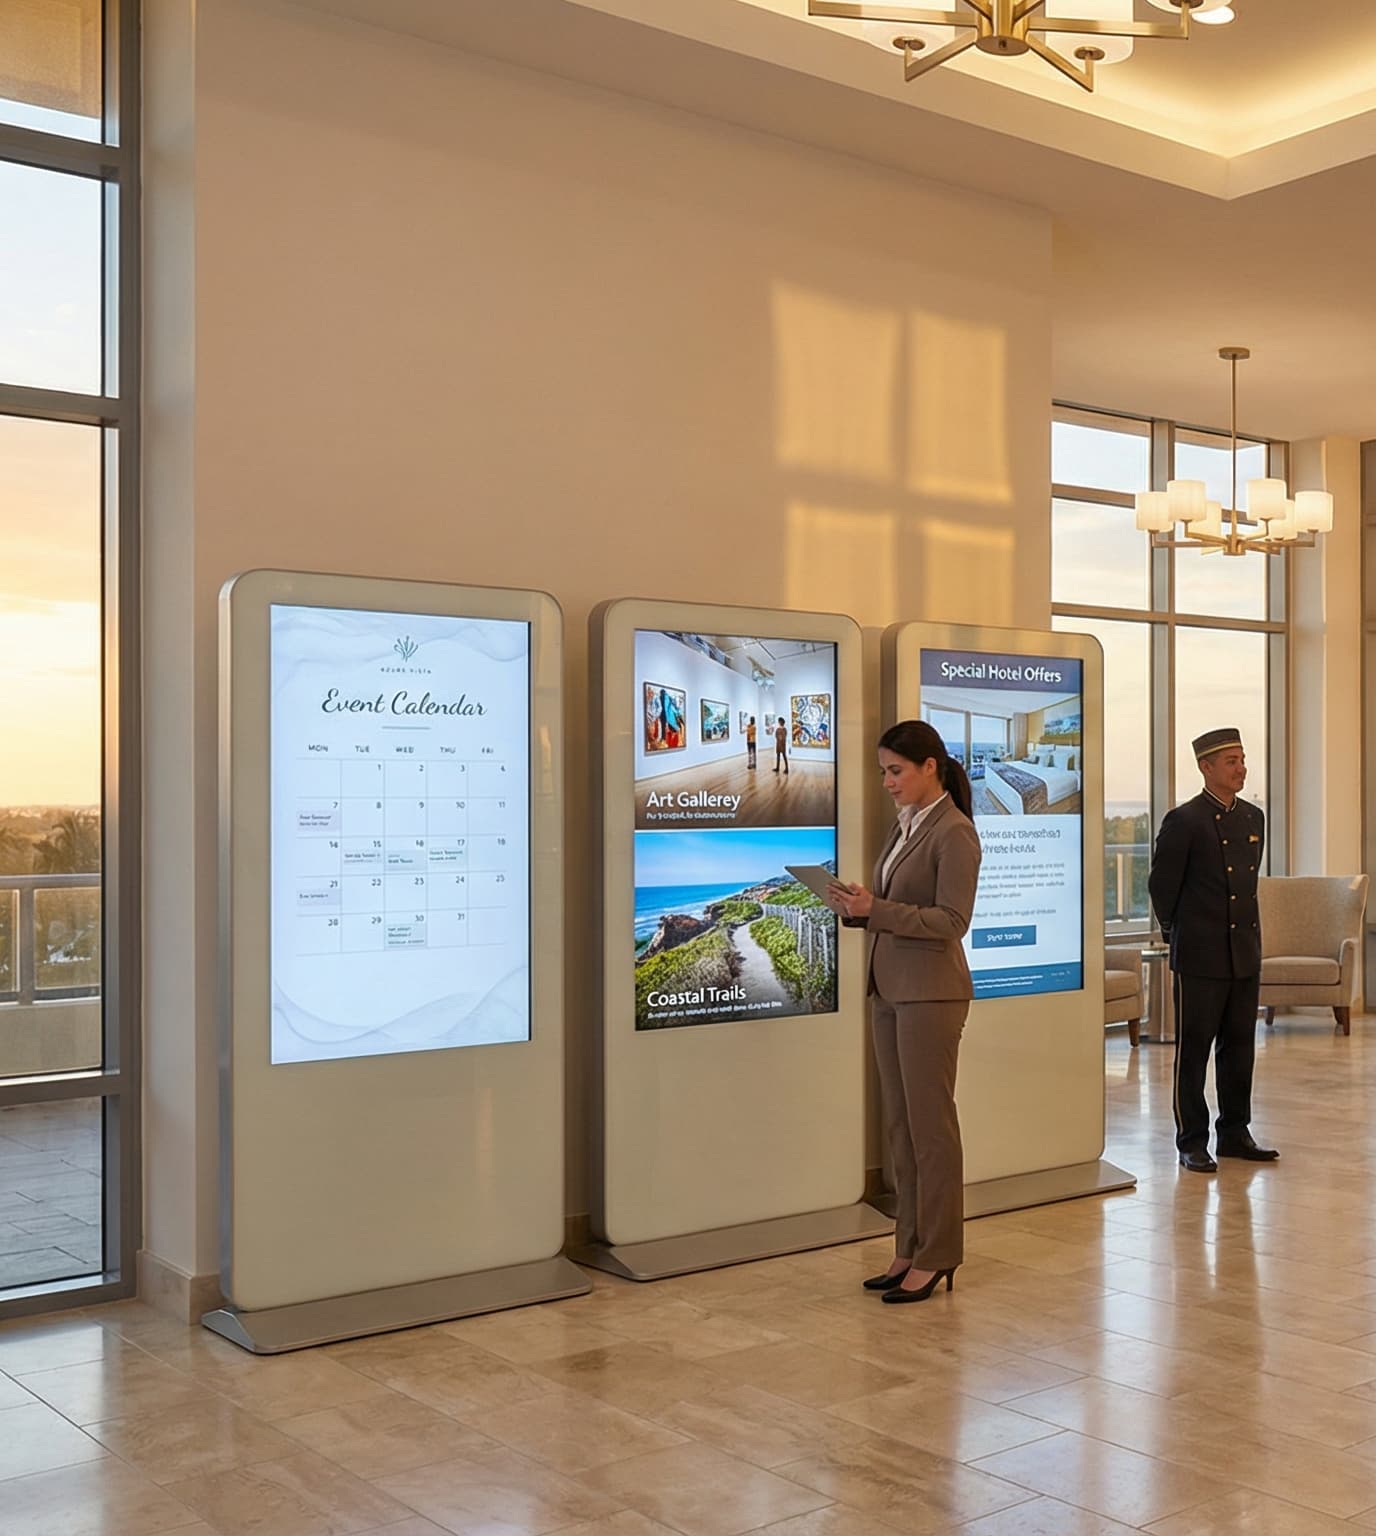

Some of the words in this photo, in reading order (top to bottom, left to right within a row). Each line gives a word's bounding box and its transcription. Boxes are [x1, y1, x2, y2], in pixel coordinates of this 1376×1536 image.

[941, 662, 985, 681] Special
[989, 665, 1022, 680] Hotel
[1024, 667, 1062, 683] Offers
[321, 688, 386, 714] Event
[391, 690, 488, 716] Calendar
[308, 744, 329, 753] MON
[354, 745, 370, 753] TUE
[395, 746, 414, 754] WED
[439, 746, 456, 754] THU
[646, 791, 674, 807] Art
[677, 791, 741, 811] Gallerey
[647, 987, 704, 1007] Coastal
[707, 984, 747, 1002] Trails
